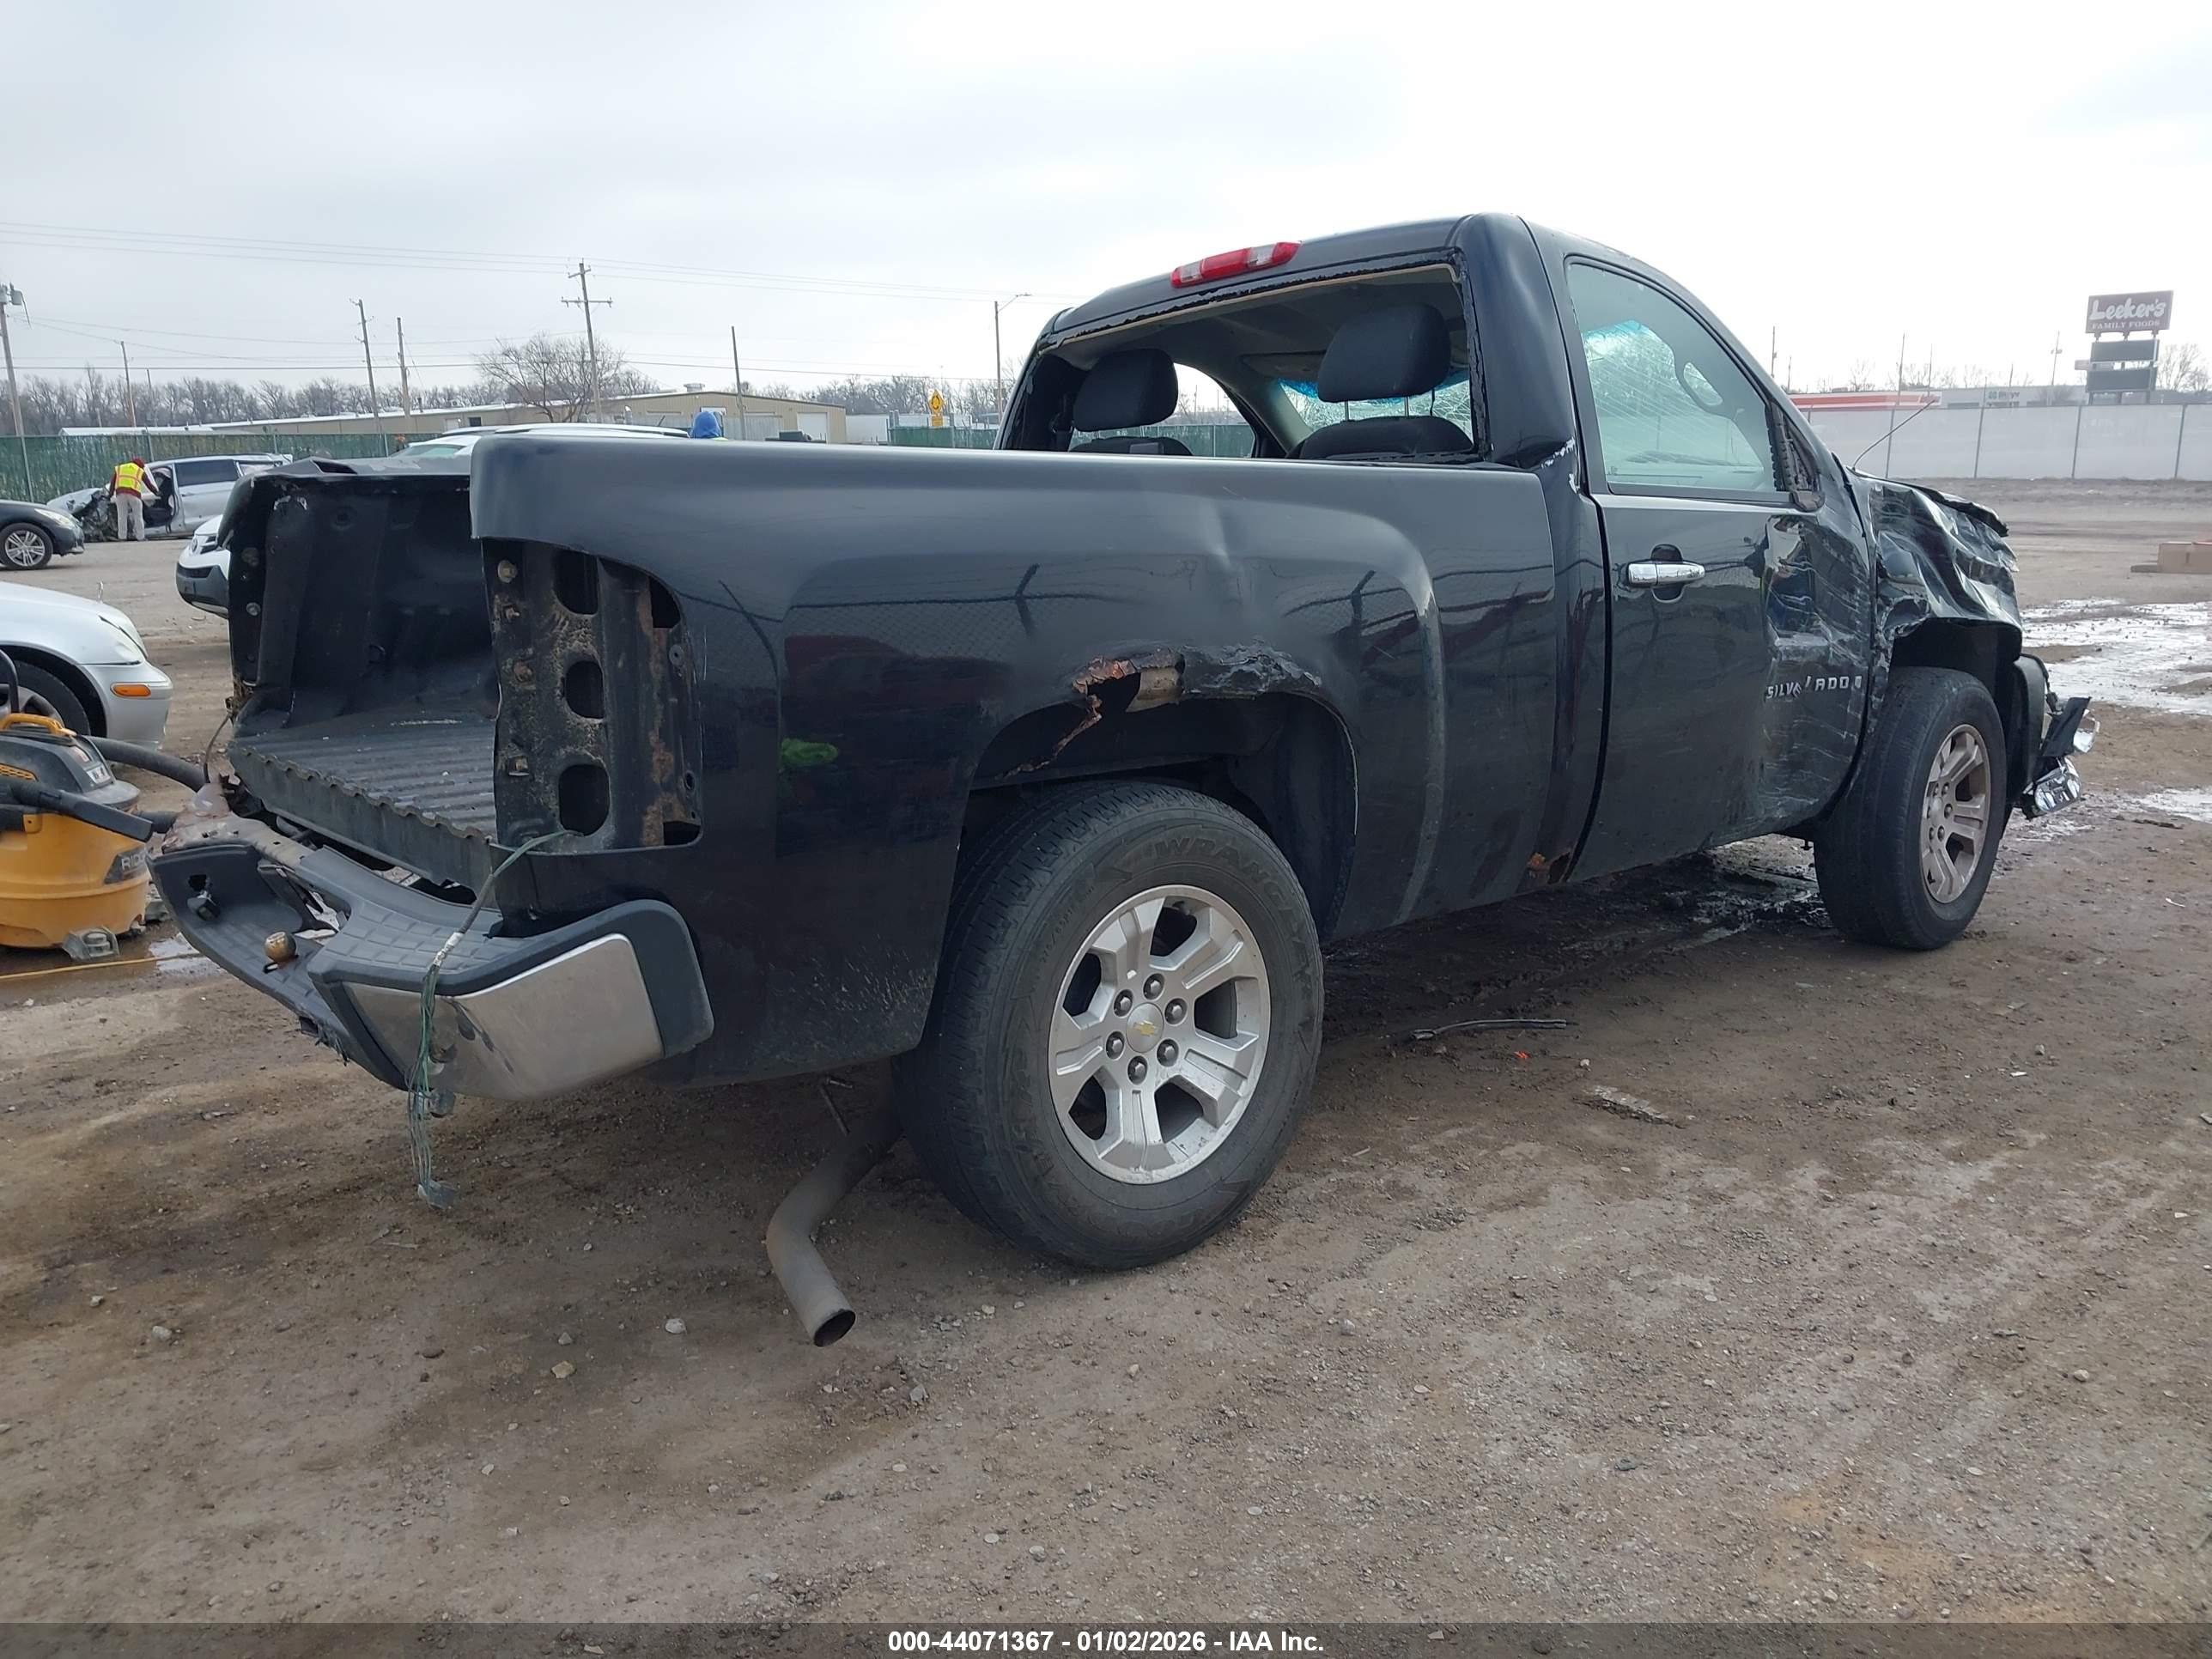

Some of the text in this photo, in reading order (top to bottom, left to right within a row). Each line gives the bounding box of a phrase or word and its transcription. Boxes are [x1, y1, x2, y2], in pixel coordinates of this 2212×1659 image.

[2088, 297, 2166, 320] Leeker's
[2092, 319, 2160, 330] FAMILY FOODS
